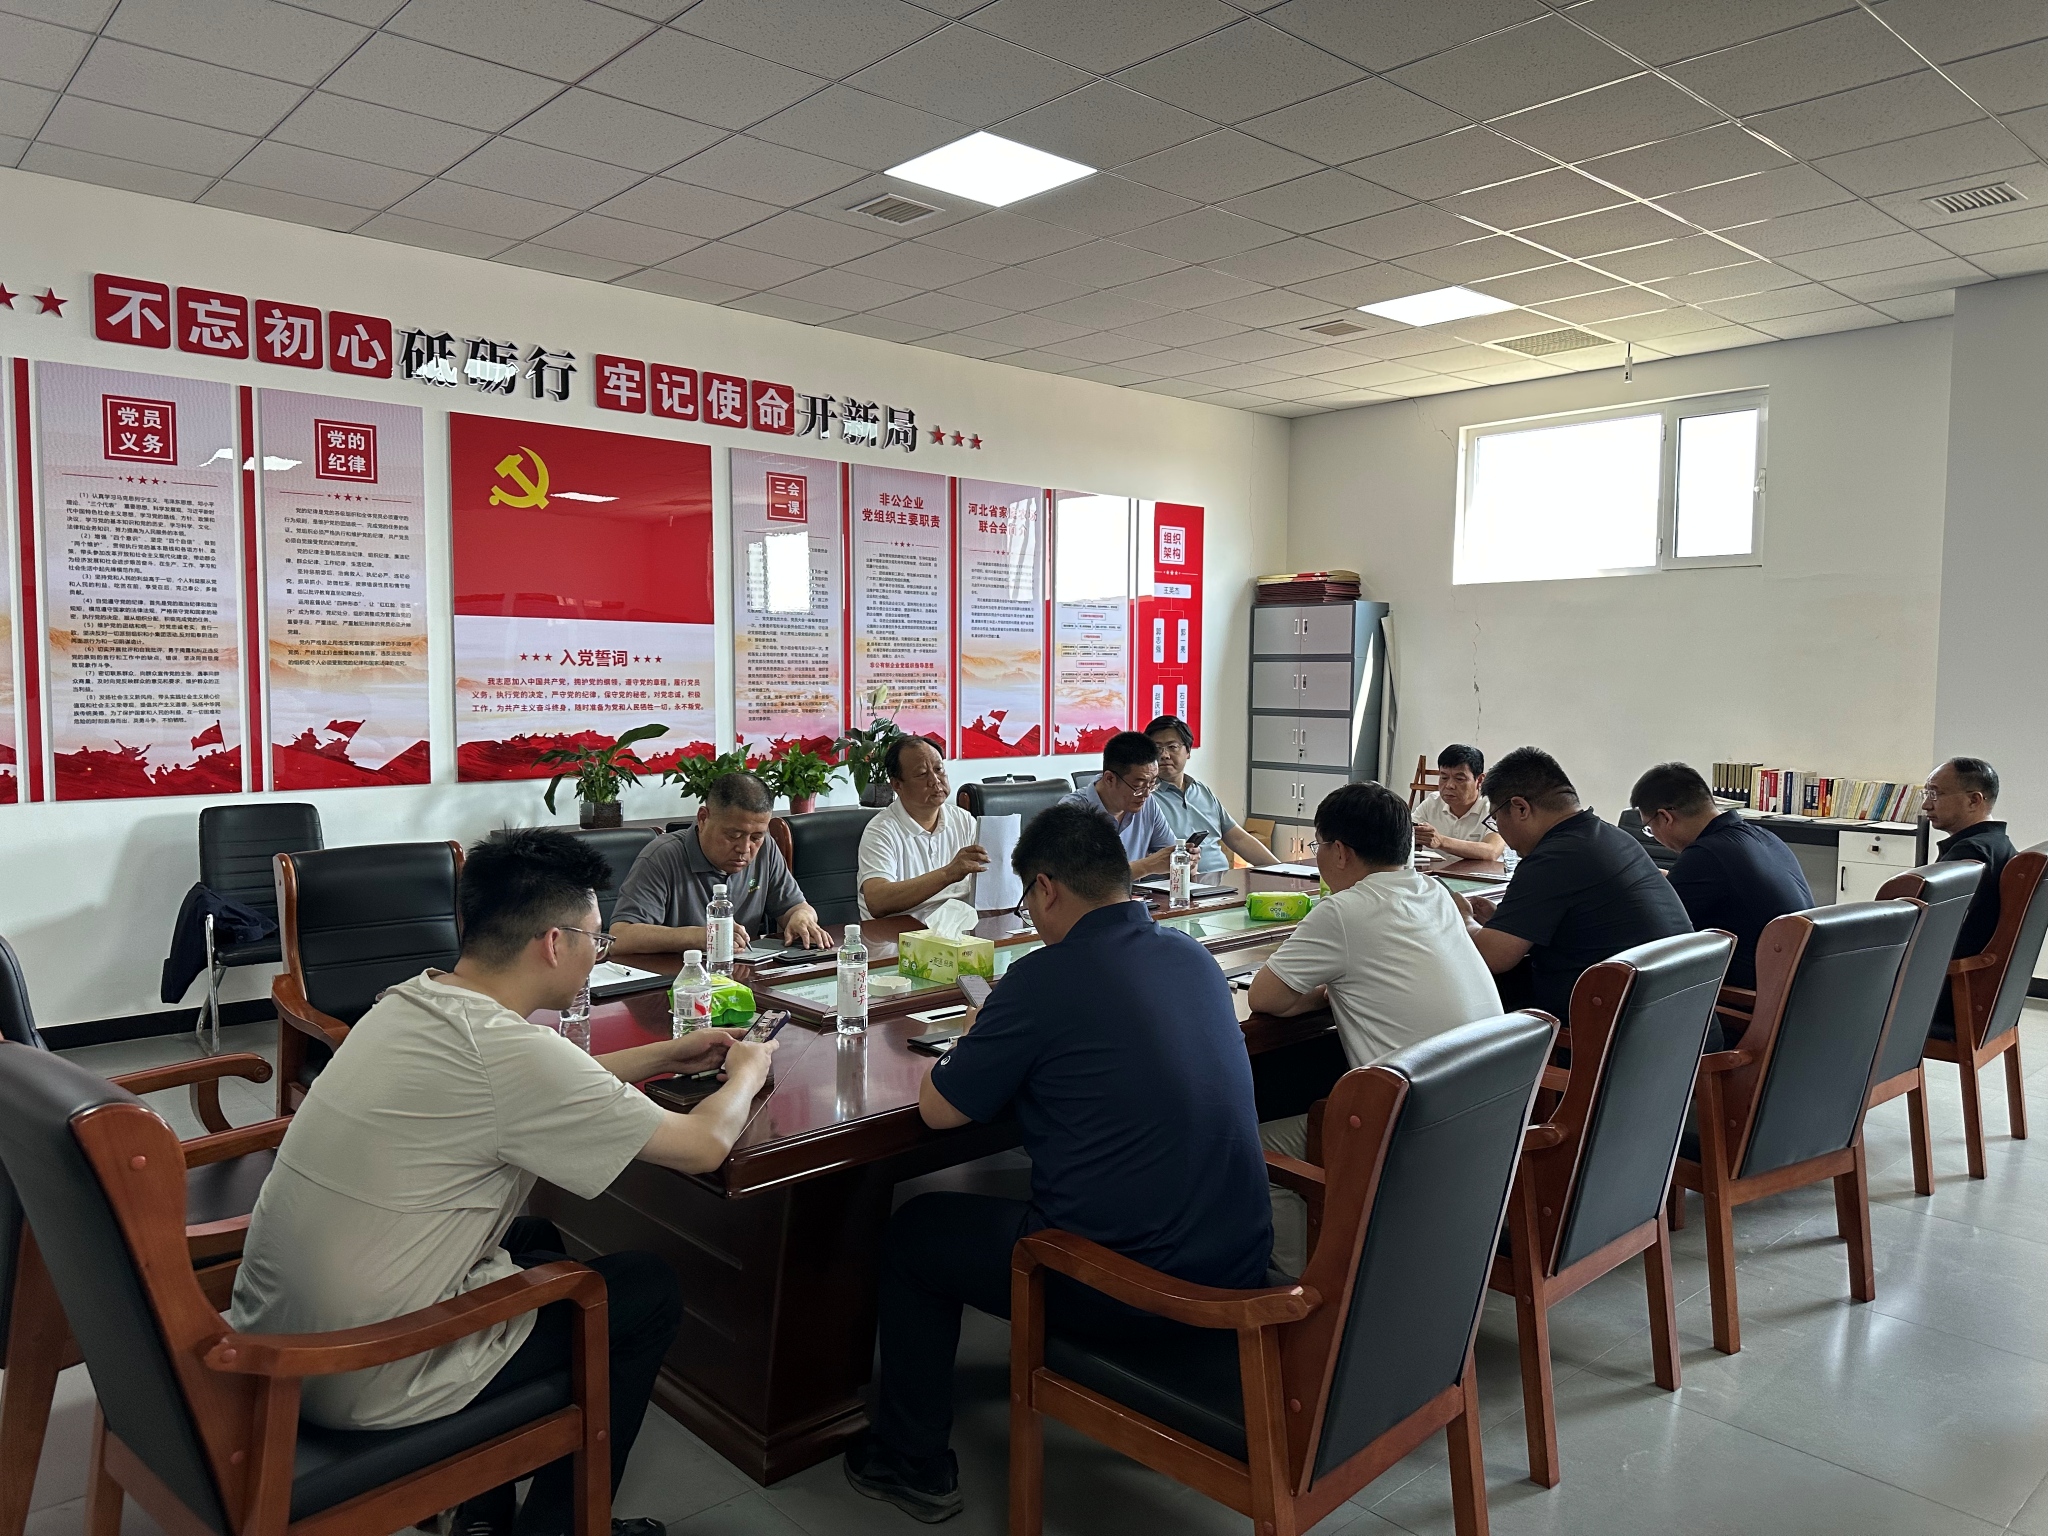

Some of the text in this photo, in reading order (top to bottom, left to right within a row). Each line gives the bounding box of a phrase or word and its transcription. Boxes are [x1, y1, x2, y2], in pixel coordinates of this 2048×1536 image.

[106, 284, 919, 453] 不忘初心砥砺行 牢记使命开新局
[118, 407, 162, 429] 党员
[118, 432, 163, 453] 义务
[327, 430, 366, 450] 党的
[328, 453, 366, 473] 纪律
[775, 482, 800, 497] 三会
[775, 501, 800, 515] 一课
[879, 493, 924, 510] 非公企业
[862, 508, 940, 528] 党组织主要职责
[1163, 531, 1181, 545] 组织
[1163, 546, 1181, 560] 架构
[559, 649, 629, 667] 入党誓词
